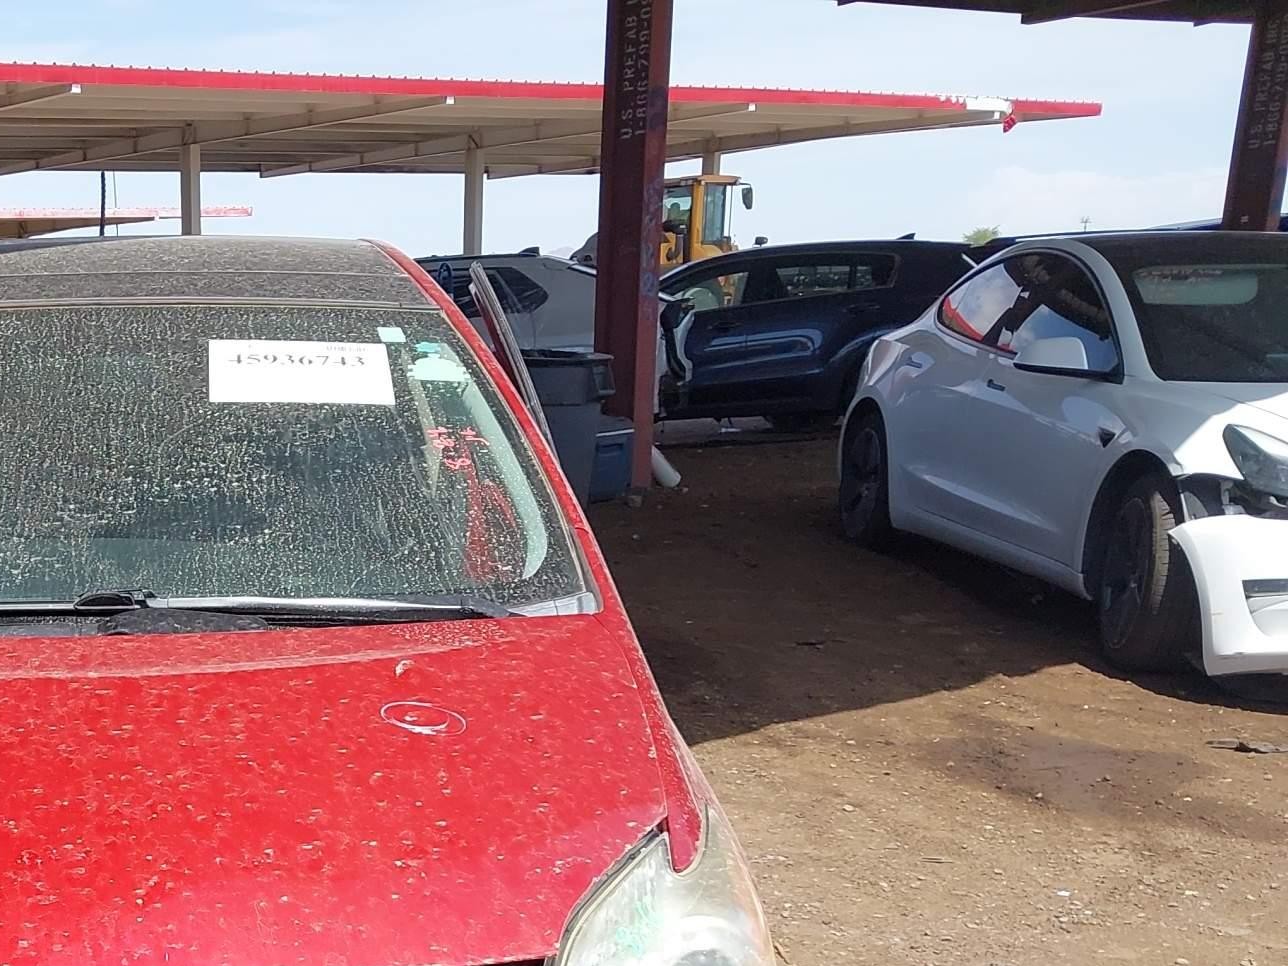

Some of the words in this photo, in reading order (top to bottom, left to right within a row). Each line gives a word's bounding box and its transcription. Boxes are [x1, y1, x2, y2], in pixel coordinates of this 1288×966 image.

[623, 15, 638, 91] PREFAB
[620, 102, 634, 139] U.S.
[228, 353, 365, 367] 45936743
